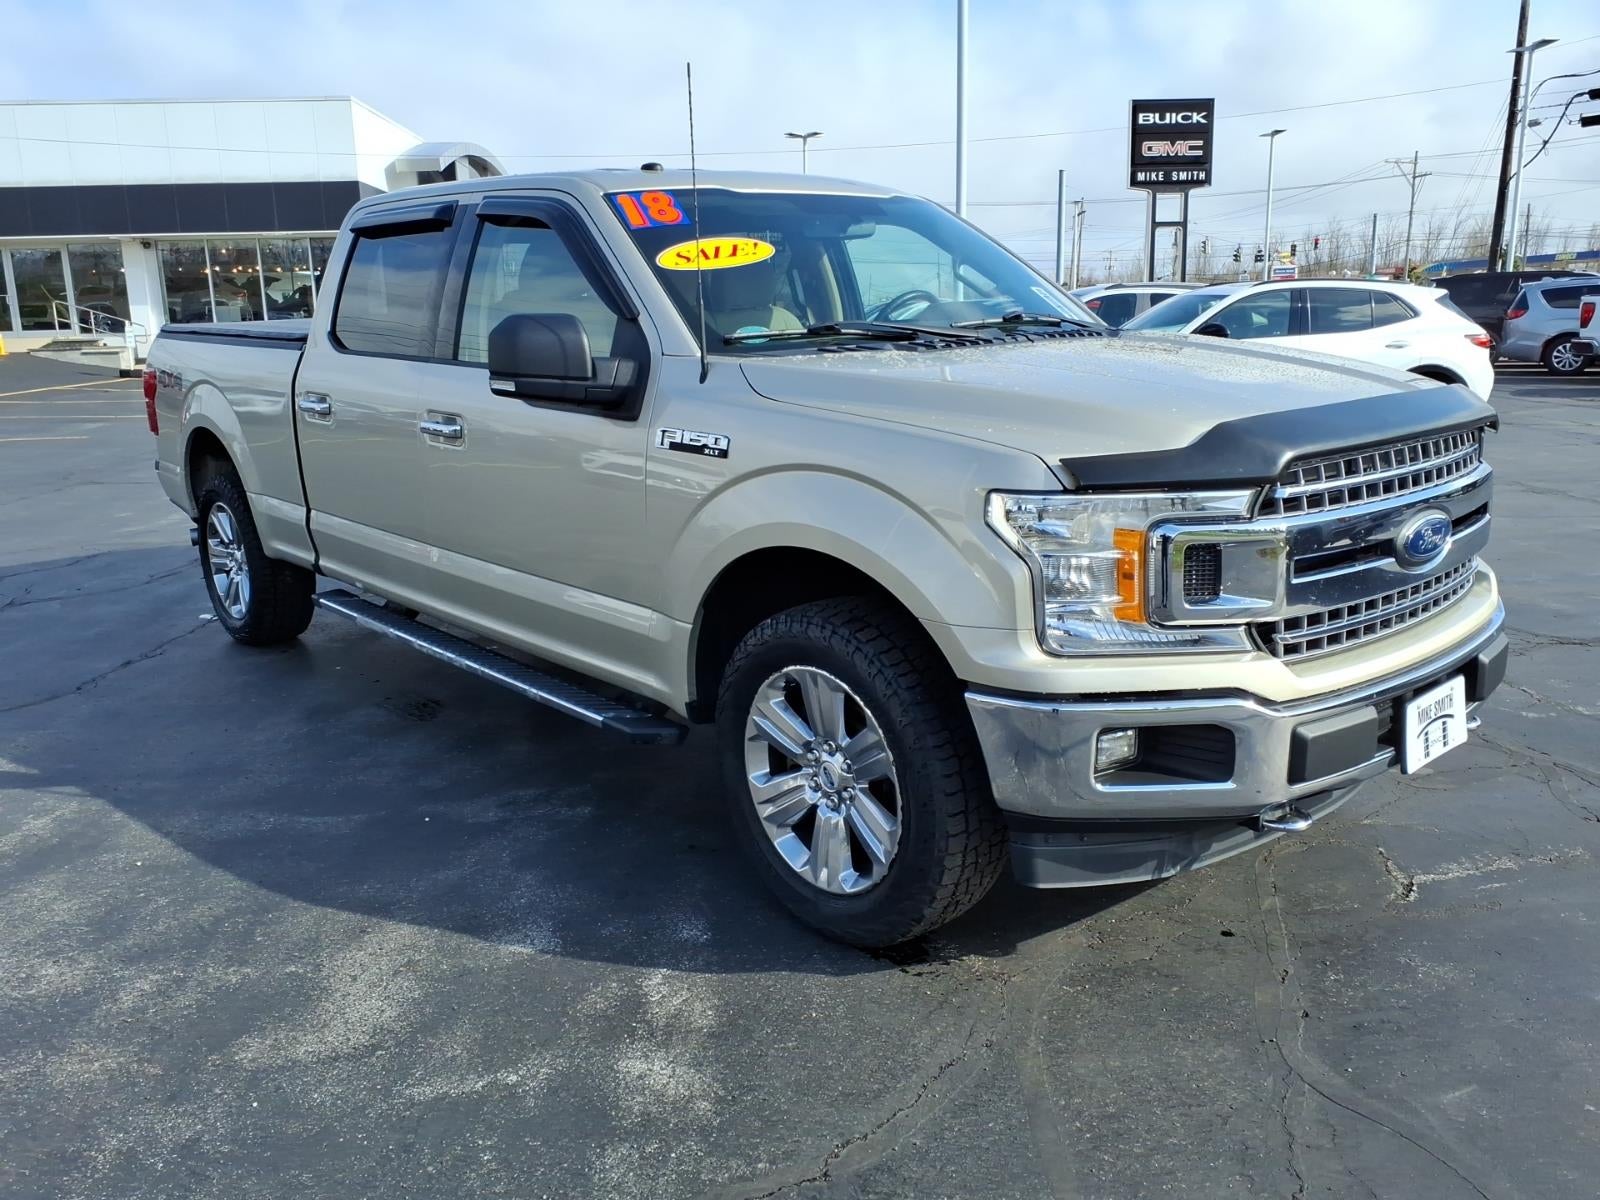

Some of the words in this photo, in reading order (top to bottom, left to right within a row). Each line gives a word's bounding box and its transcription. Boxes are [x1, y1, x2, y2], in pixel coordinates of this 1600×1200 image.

[1138, 112, 1208, 124] BUICK
[1141, 140, 1204, 157] GMC
[1137, 171, 1165, 181] MIKE
[1172, 170, 1206, 181] SMITH
[617, 190, 684, 229] 18
[674, 241, 759, 266] SALE!
[703, 448, 720, 456] XLT
[1417, 703, 1433, 727] MIKE
[1433, 693, 1454, 717] SMITH
